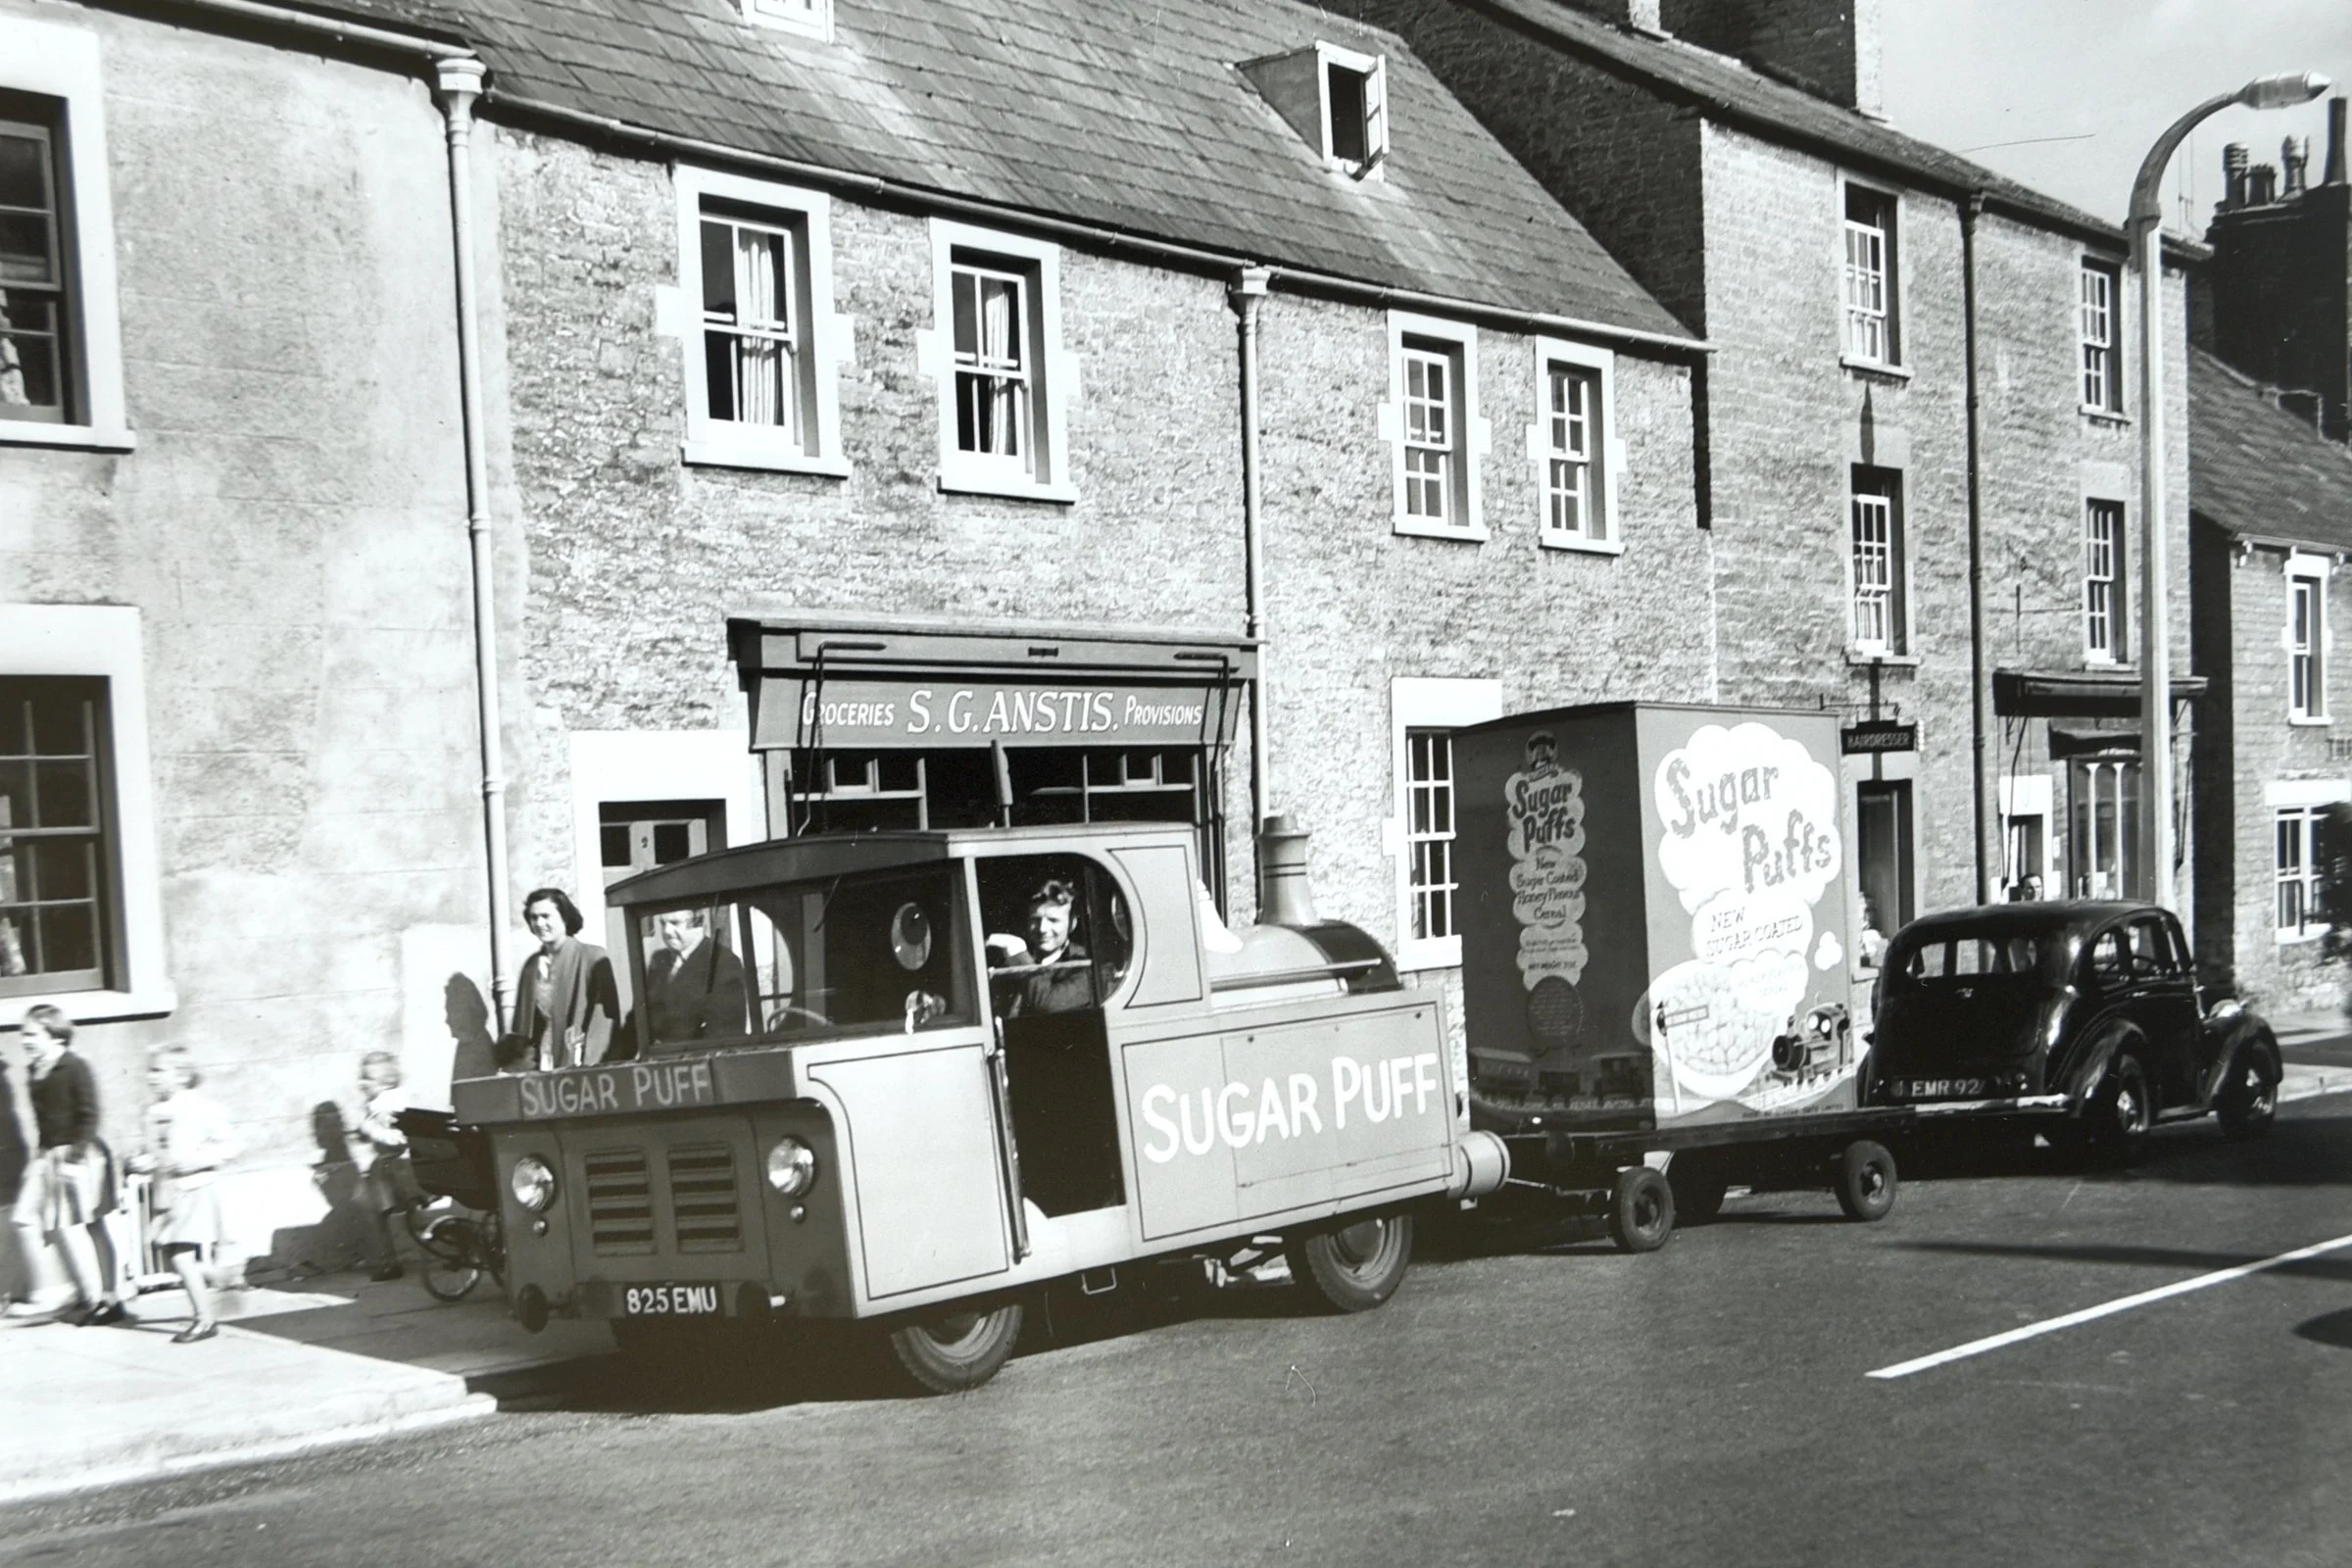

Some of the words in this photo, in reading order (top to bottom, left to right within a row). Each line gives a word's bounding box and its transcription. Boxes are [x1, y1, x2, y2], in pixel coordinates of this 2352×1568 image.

[1123, 695, 1202, 727] PROVISIONS
[1846, 732, 1910, 749] HAIRDRESSER
[1512, 780, 1572, 819] Sugar
[1666, 758, 1779, 839] Sugar
[1523, 807, 1575, 854] Puffs
[1741, 809, 1832, 894] Puffs
[1706, 930, 1752, 957] SUGAR
[1754, 915, 1803, 942] COATED
[1711, 906, 1745, 933] NEW
[520, 1074, 618, 1116] SUGAR
[633, 1064, 713, 1107] PUFF
[1143, 1073, 1322, 1163] SUGAR
[1331, 1053, 1437, 1130] PUFF
[1912, 1079, 1950, 1097] EMR
[626, 1289, 669, 1314] 825
[673, 1286, 717, 1313] EMU
